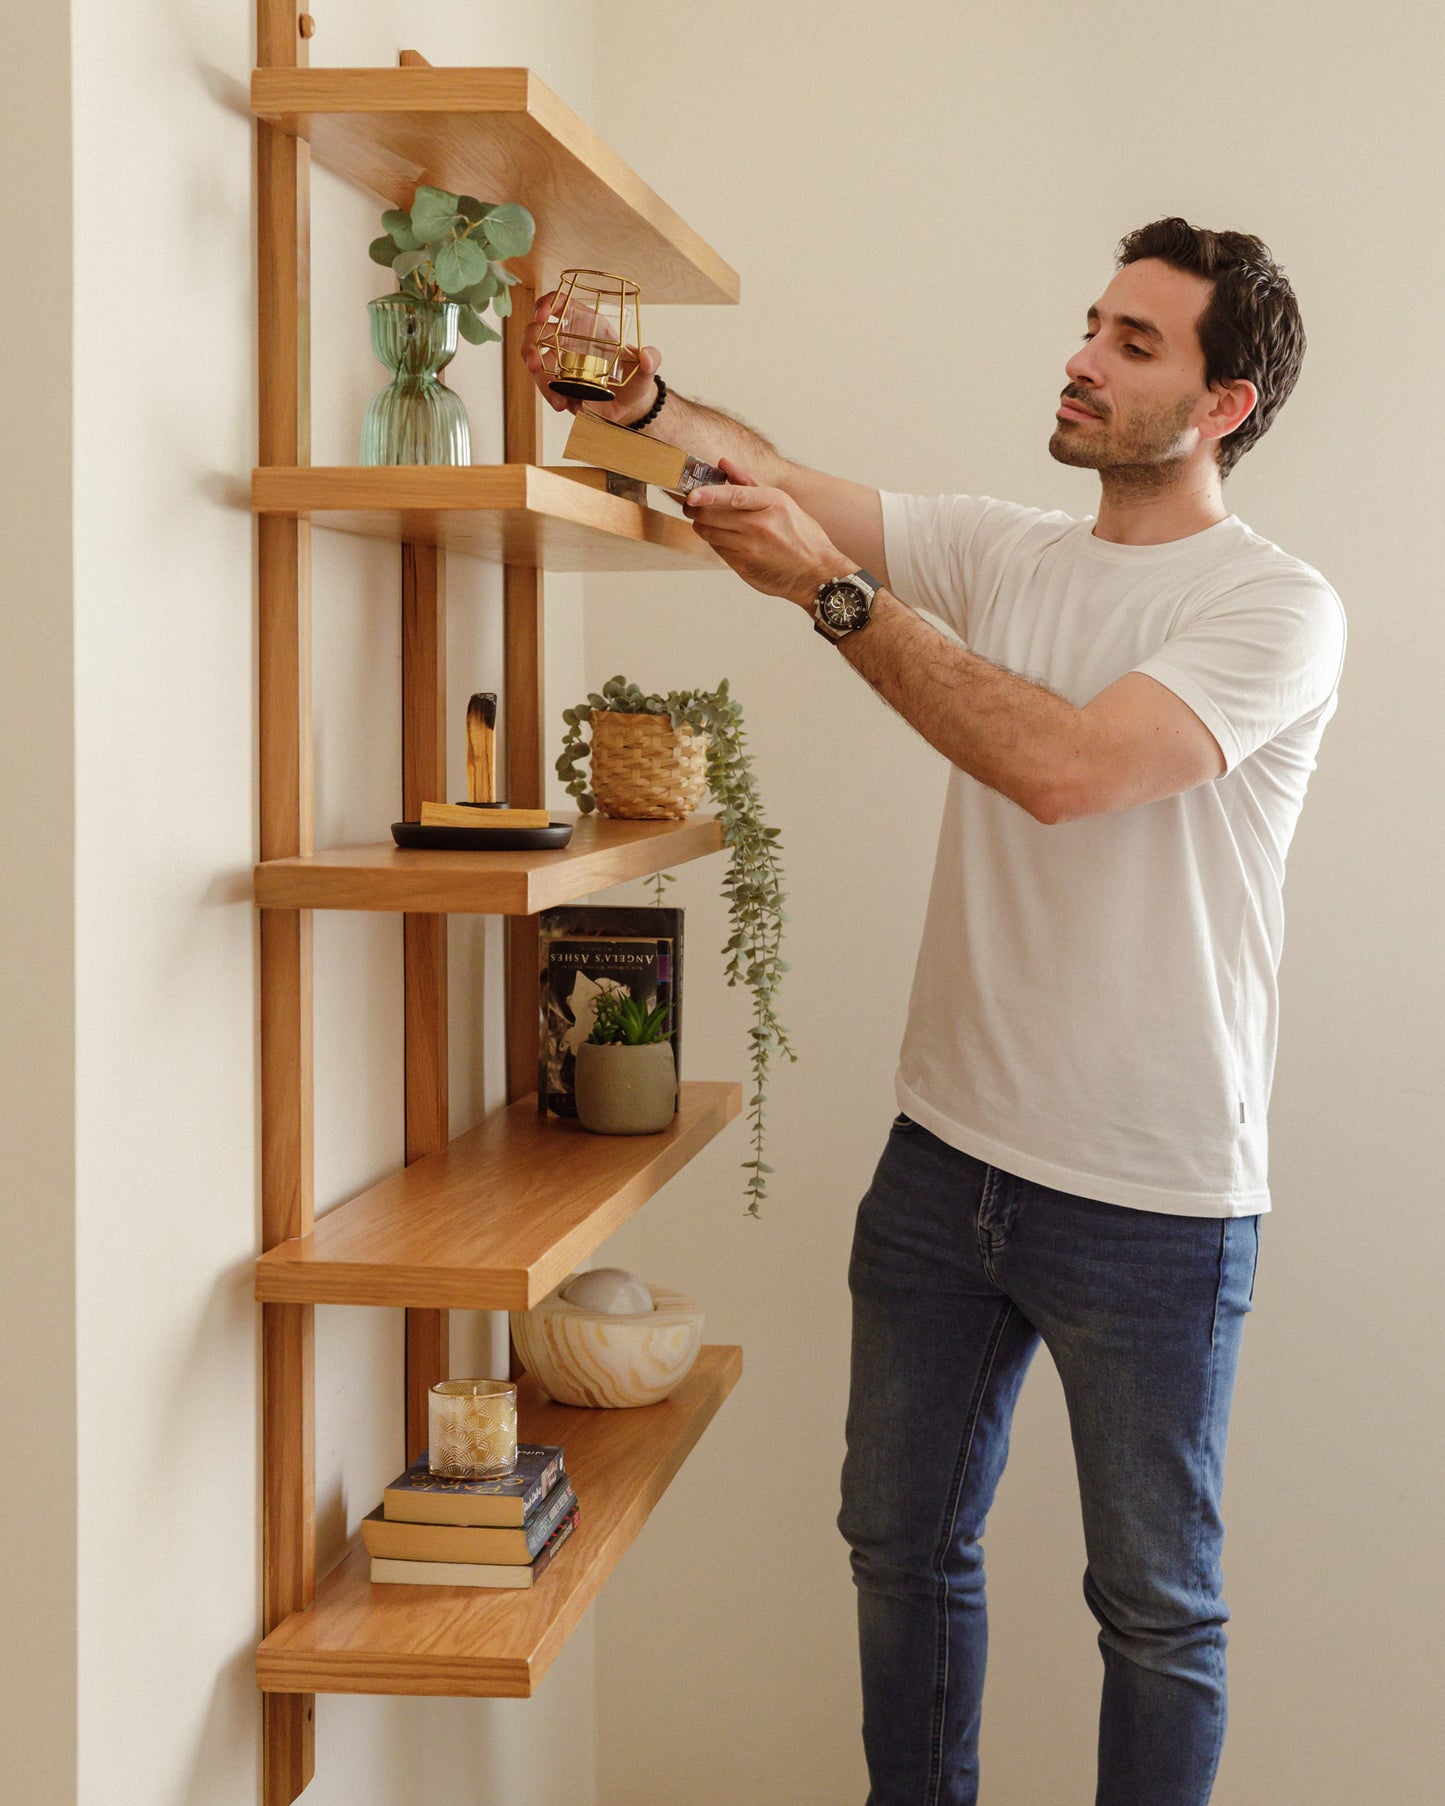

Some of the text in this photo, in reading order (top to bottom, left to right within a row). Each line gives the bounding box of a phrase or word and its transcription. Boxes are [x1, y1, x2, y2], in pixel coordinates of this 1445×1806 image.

[550, 954, 654, 964] ANGELA'S ASHES
[412, 1482, 504, 1494] Paulo
